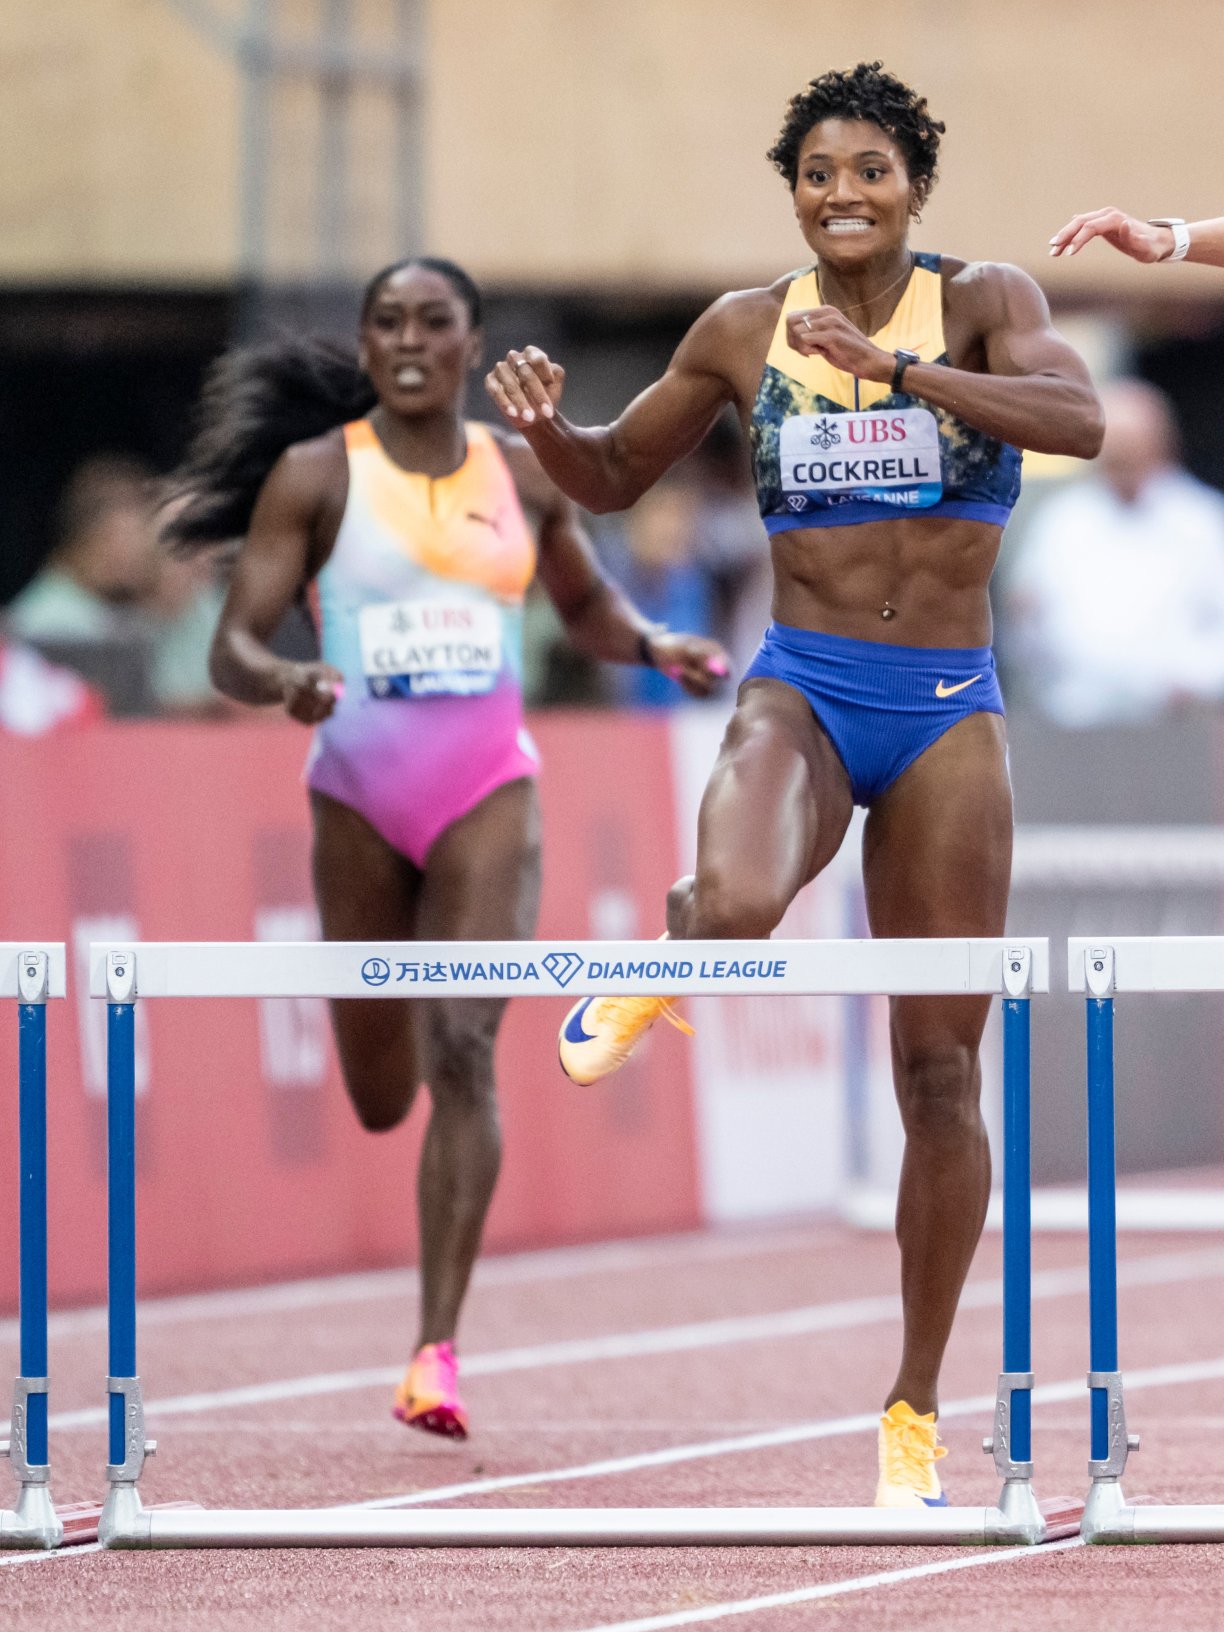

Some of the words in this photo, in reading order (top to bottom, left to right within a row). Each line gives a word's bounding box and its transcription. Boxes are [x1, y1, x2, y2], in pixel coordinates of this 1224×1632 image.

[846, 417, 907, 444] UBS
[792, 457, 929, 484] COCKRELL
[422, 607, 474, 629] UBS
[373, 644, 492, 669] CLAYTON
[587, 961, 693, 980] DIAMOND
[699, 960, 787, 979] LEAGUE
